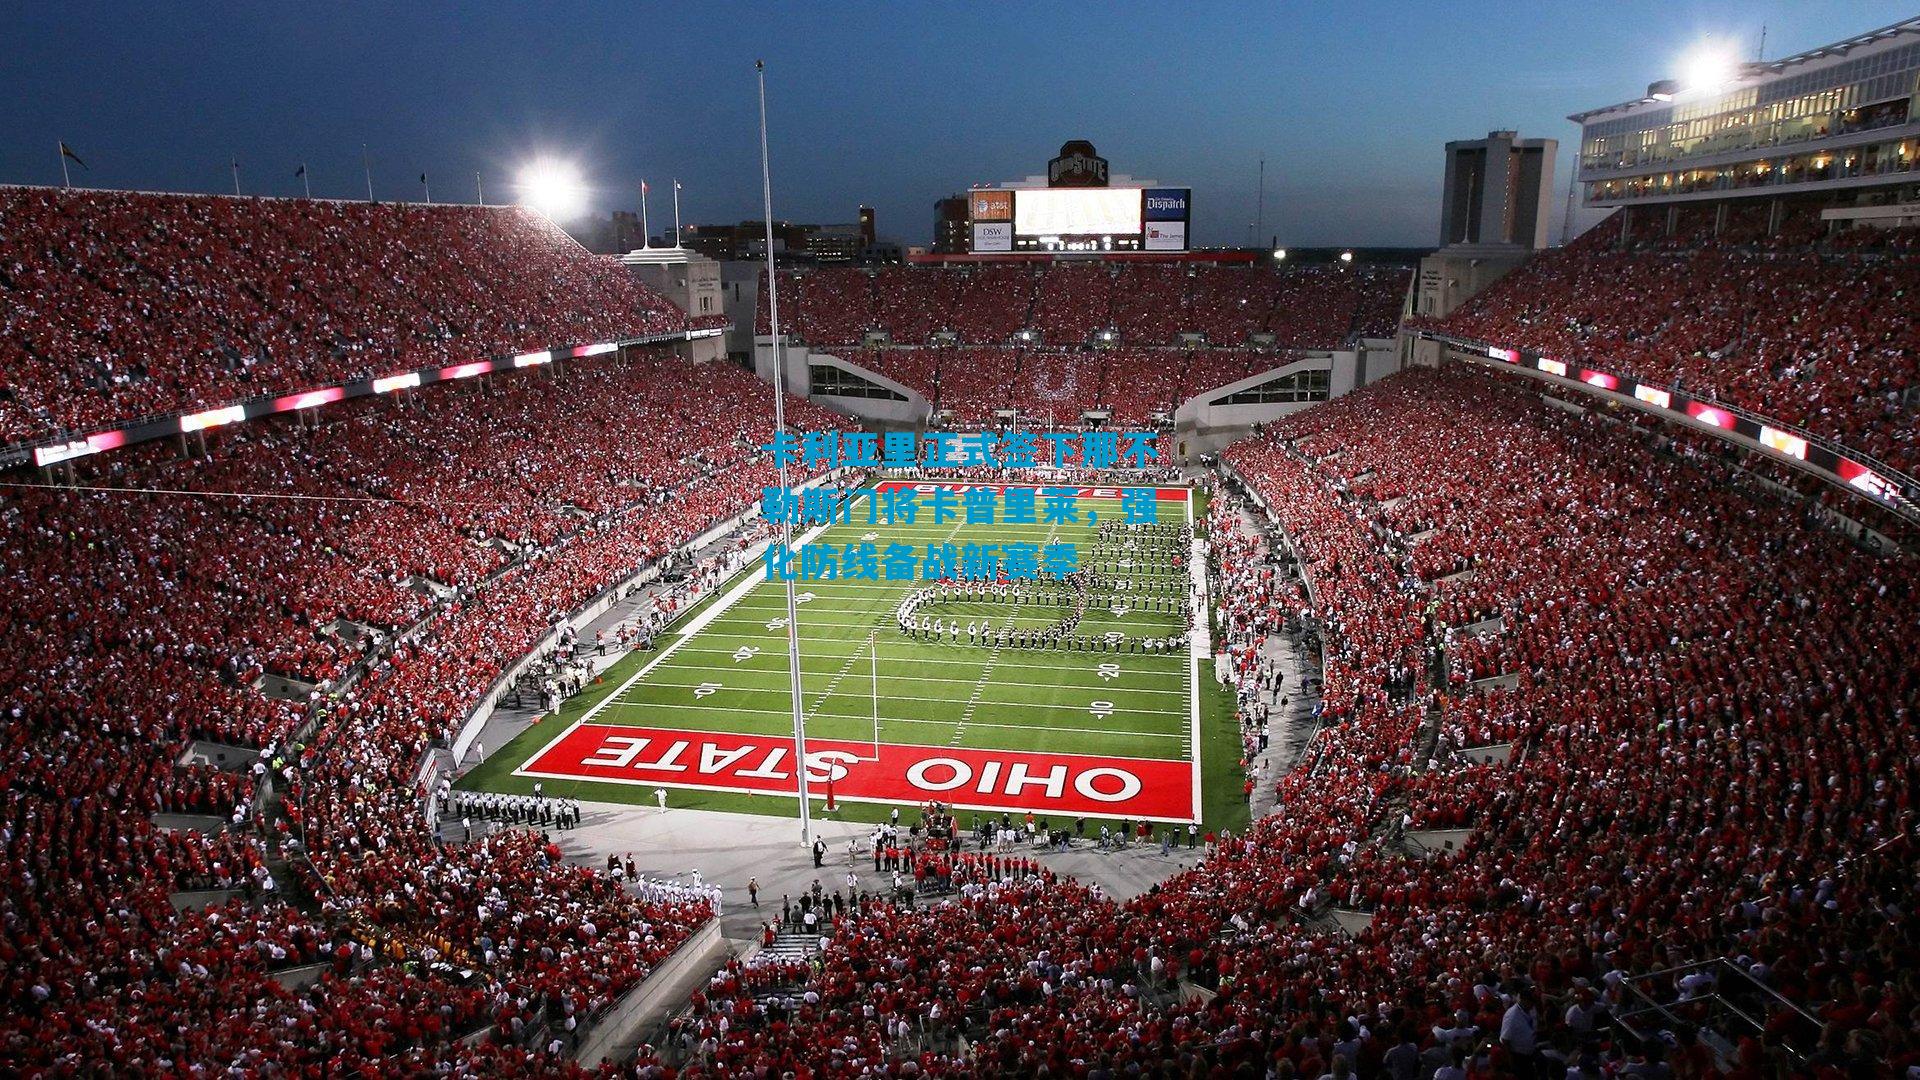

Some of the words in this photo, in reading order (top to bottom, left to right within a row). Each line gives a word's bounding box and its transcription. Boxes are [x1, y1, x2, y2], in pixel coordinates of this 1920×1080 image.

[1147, 197, 1185, 211] Dispatch
[1097, 663, 1120, 678] 20
[1089, 701, 1114, 714] 10
[580, 736, 861, 783] STATE
[905, 757, 1142, 802] OHIO
